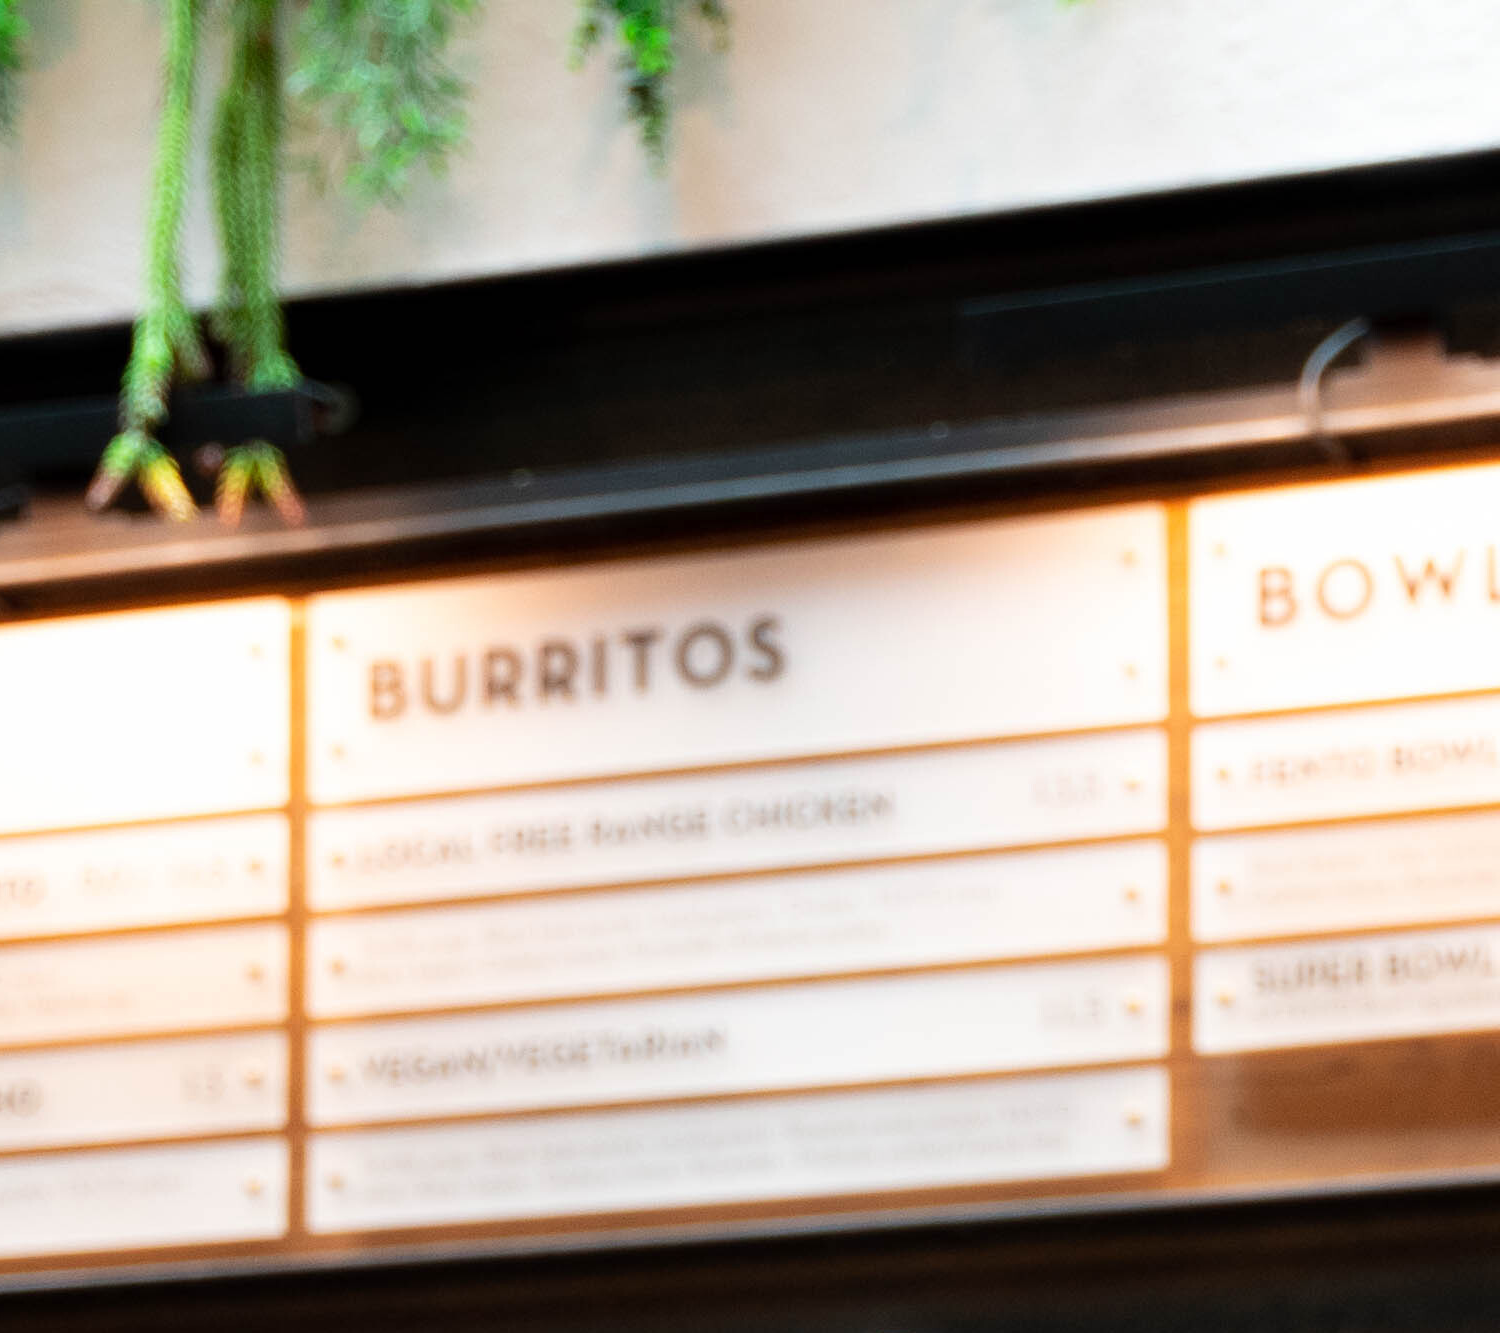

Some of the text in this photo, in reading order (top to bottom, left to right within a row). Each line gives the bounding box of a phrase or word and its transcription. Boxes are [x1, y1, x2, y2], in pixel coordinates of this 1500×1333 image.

[368, 616, 788, 722] BURRITOS
[1391, 736, 1500, 776] BOWL
[1253, 950, 1372, 994] SUPER
[1383, 939, 1496, 981] BOWL
